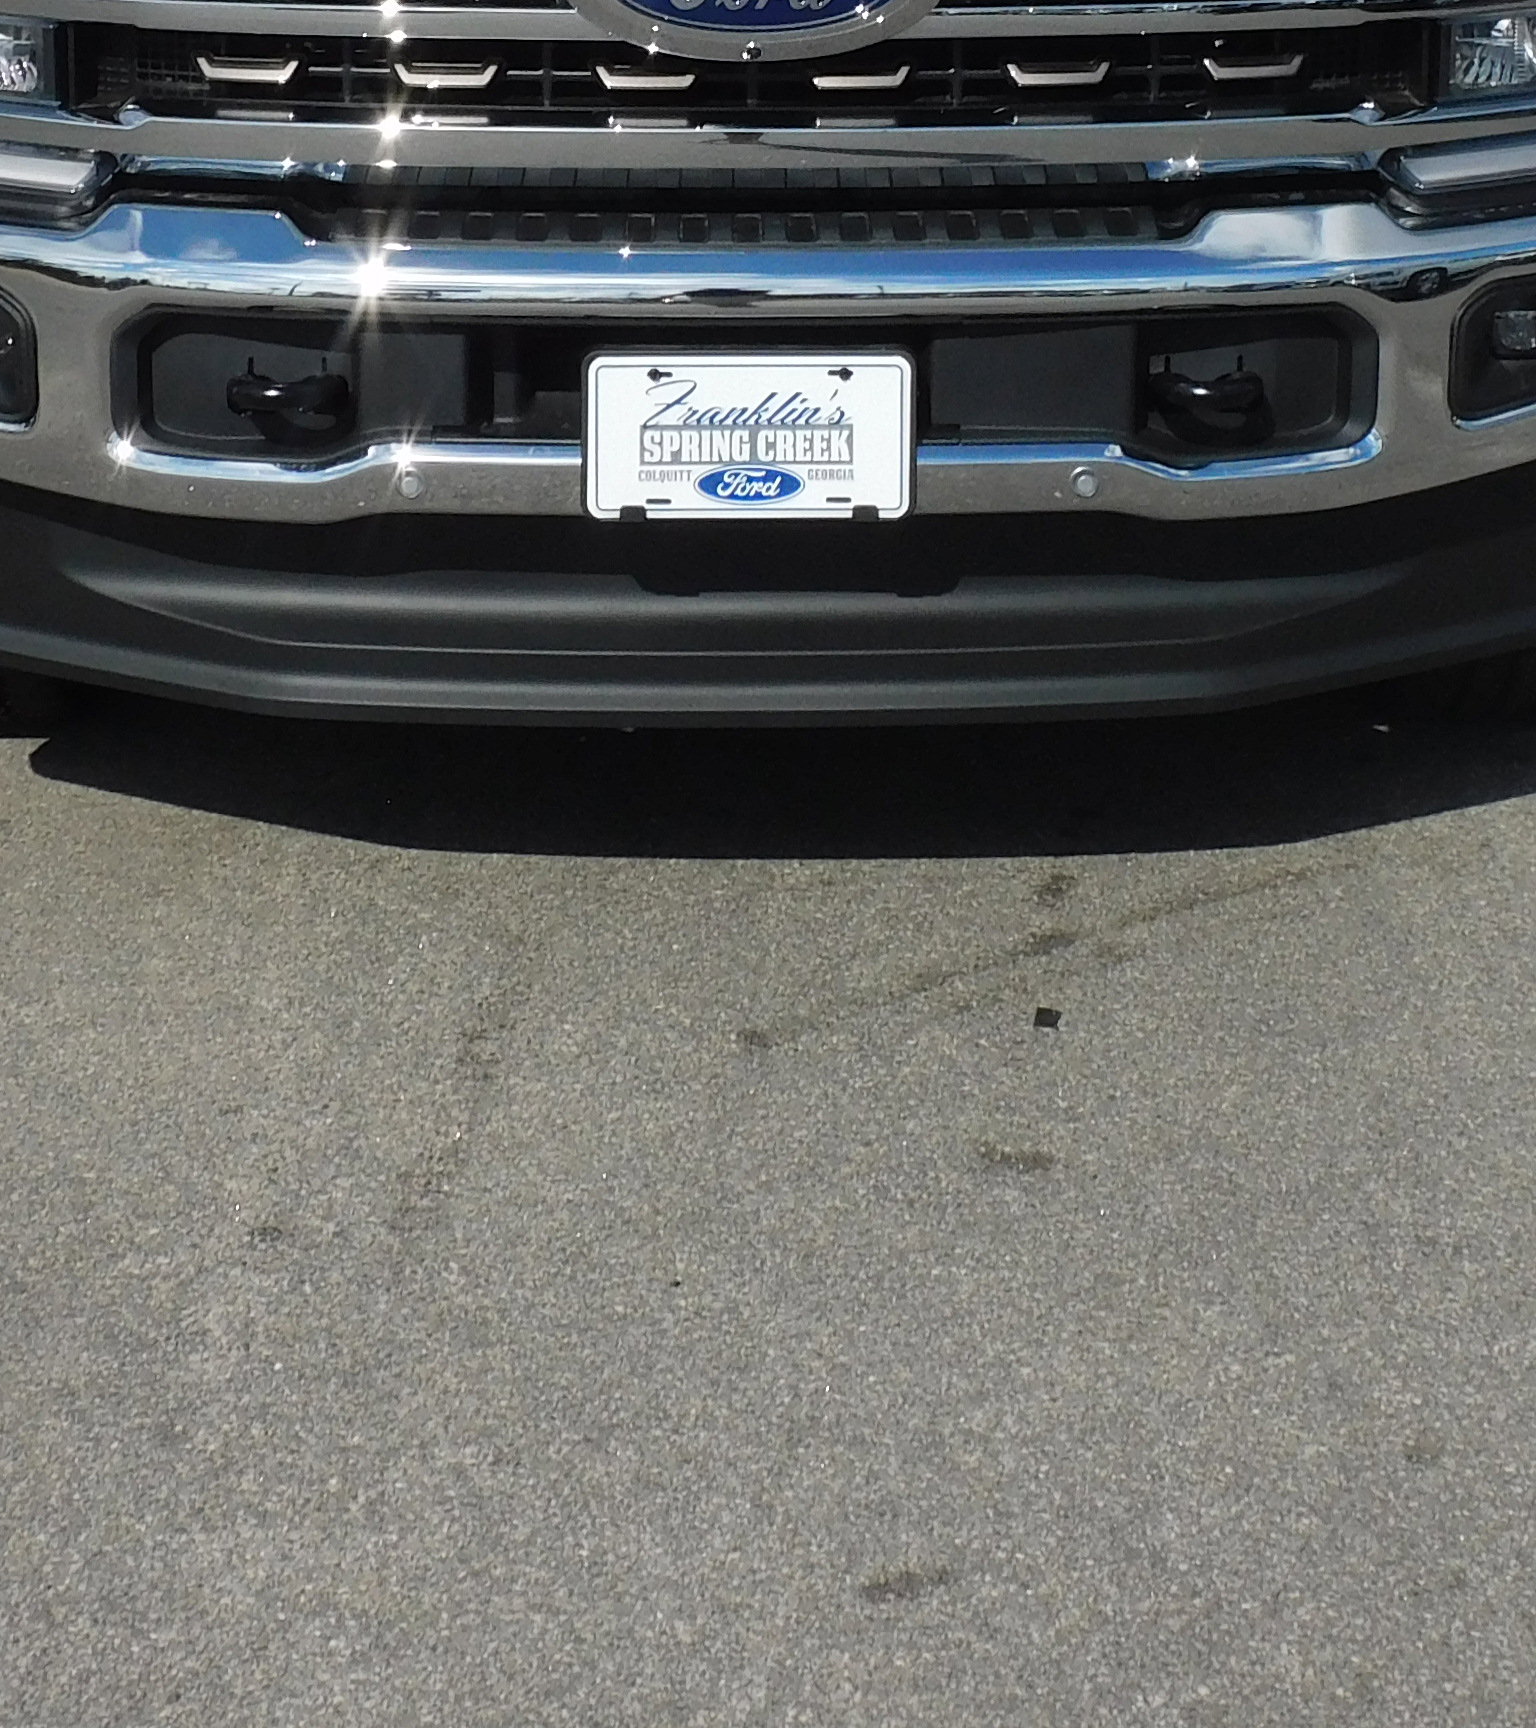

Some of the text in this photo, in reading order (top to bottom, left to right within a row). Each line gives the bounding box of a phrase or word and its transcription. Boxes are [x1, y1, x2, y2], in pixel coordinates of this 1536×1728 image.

[643, 379, 852, 429] Franklin's
[643, 429, 851, 463] SPRING CREEK
[638, 469, 693, 483] COLQUITT
[716, 470, 782, 498] Ford
[807, 468, 855, 481] GEORGIA
